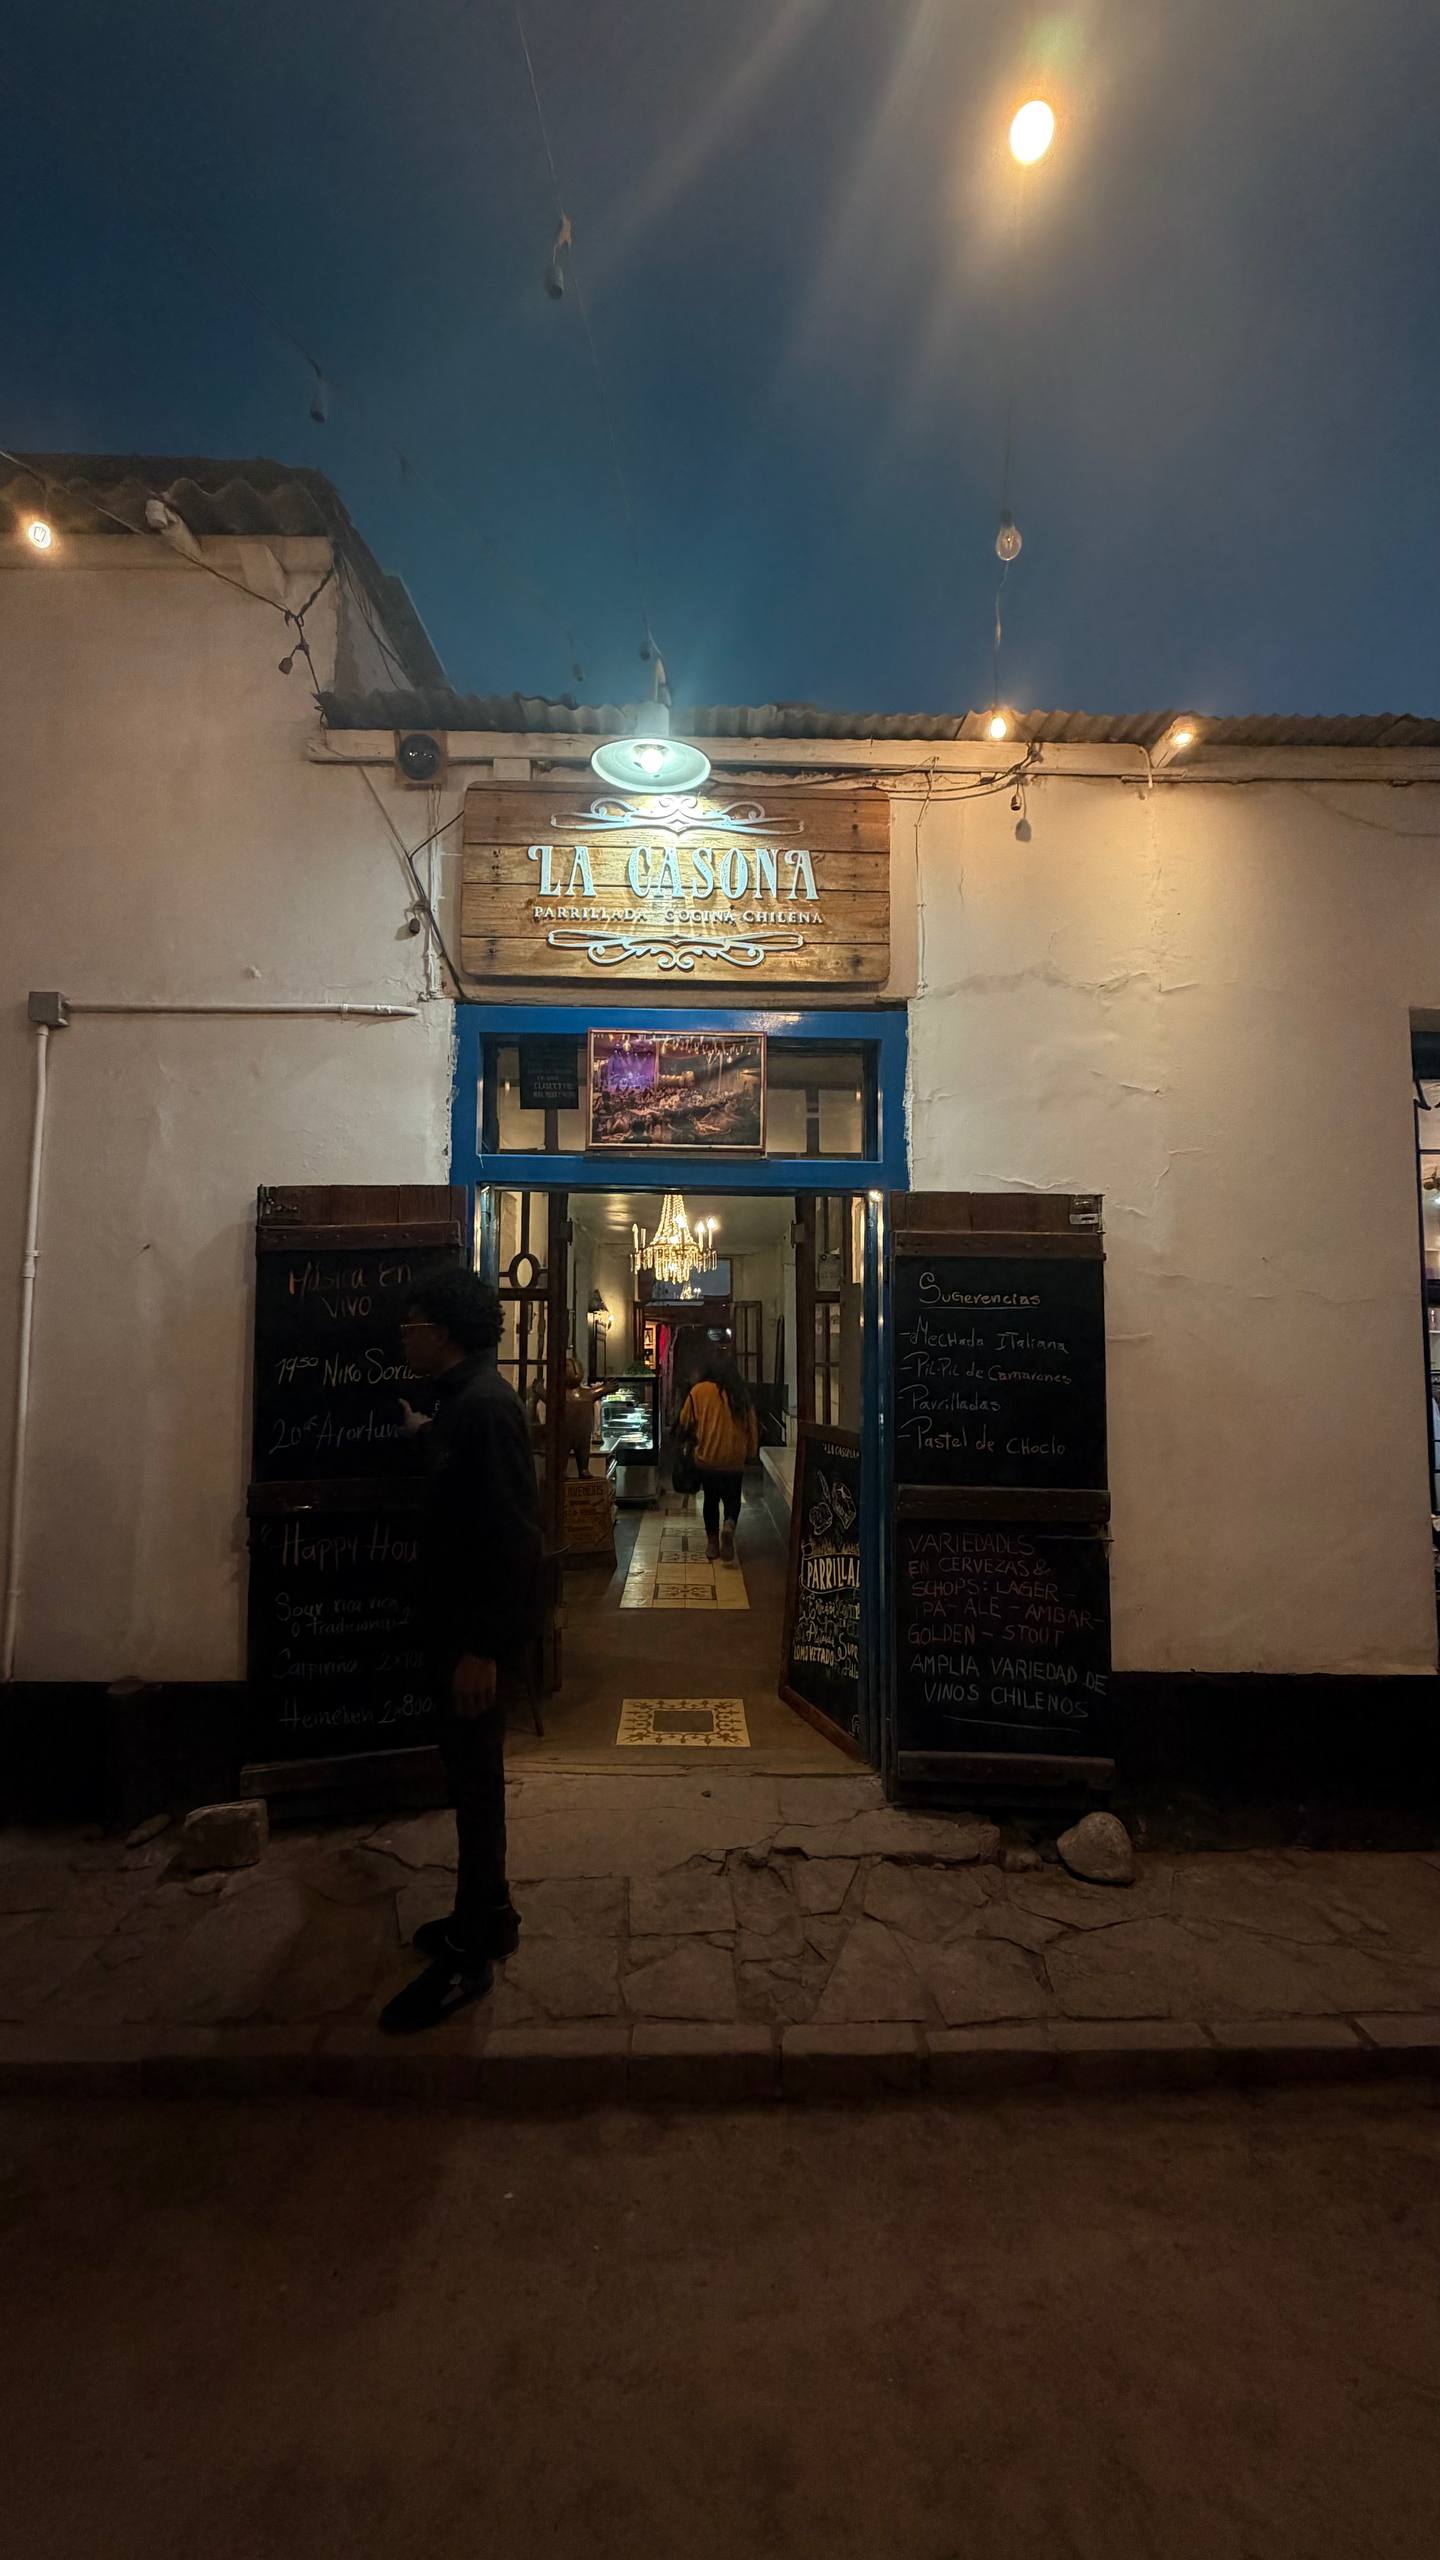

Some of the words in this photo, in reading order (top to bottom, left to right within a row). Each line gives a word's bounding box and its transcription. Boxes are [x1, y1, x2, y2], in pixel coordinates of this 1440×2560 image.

[528, 845, 597, 897] LA
[628, 846, 820, 900] CASONA
[533, 905, 649, 922] PARRILLADA
[664, 908, 736, 924] COCINA
[743, 910, 825, 925] CHILENA
[966, 1360, 986, 1379] de
[976, 1423, 995, 1453] de
[908, 1559, 929, 1577] EN
[938, 1557, 1030, 1577] CERVEZAS
[995, 1580, 1060, 1602] LAGER
[907, 1622, 977, 1648] GOLDEN
[1002, 1624, 1065, 1649] STOUT
[909, 1652, 981, 1678] AMPLIA
[990, 1656, 1078, 1687] VARIEDAD
[1084, 1670, 1109, 1696] DE
[923, 1681, 981, 1703] VINOS
[990, 1685, 1089, 1718] CHILENOS
